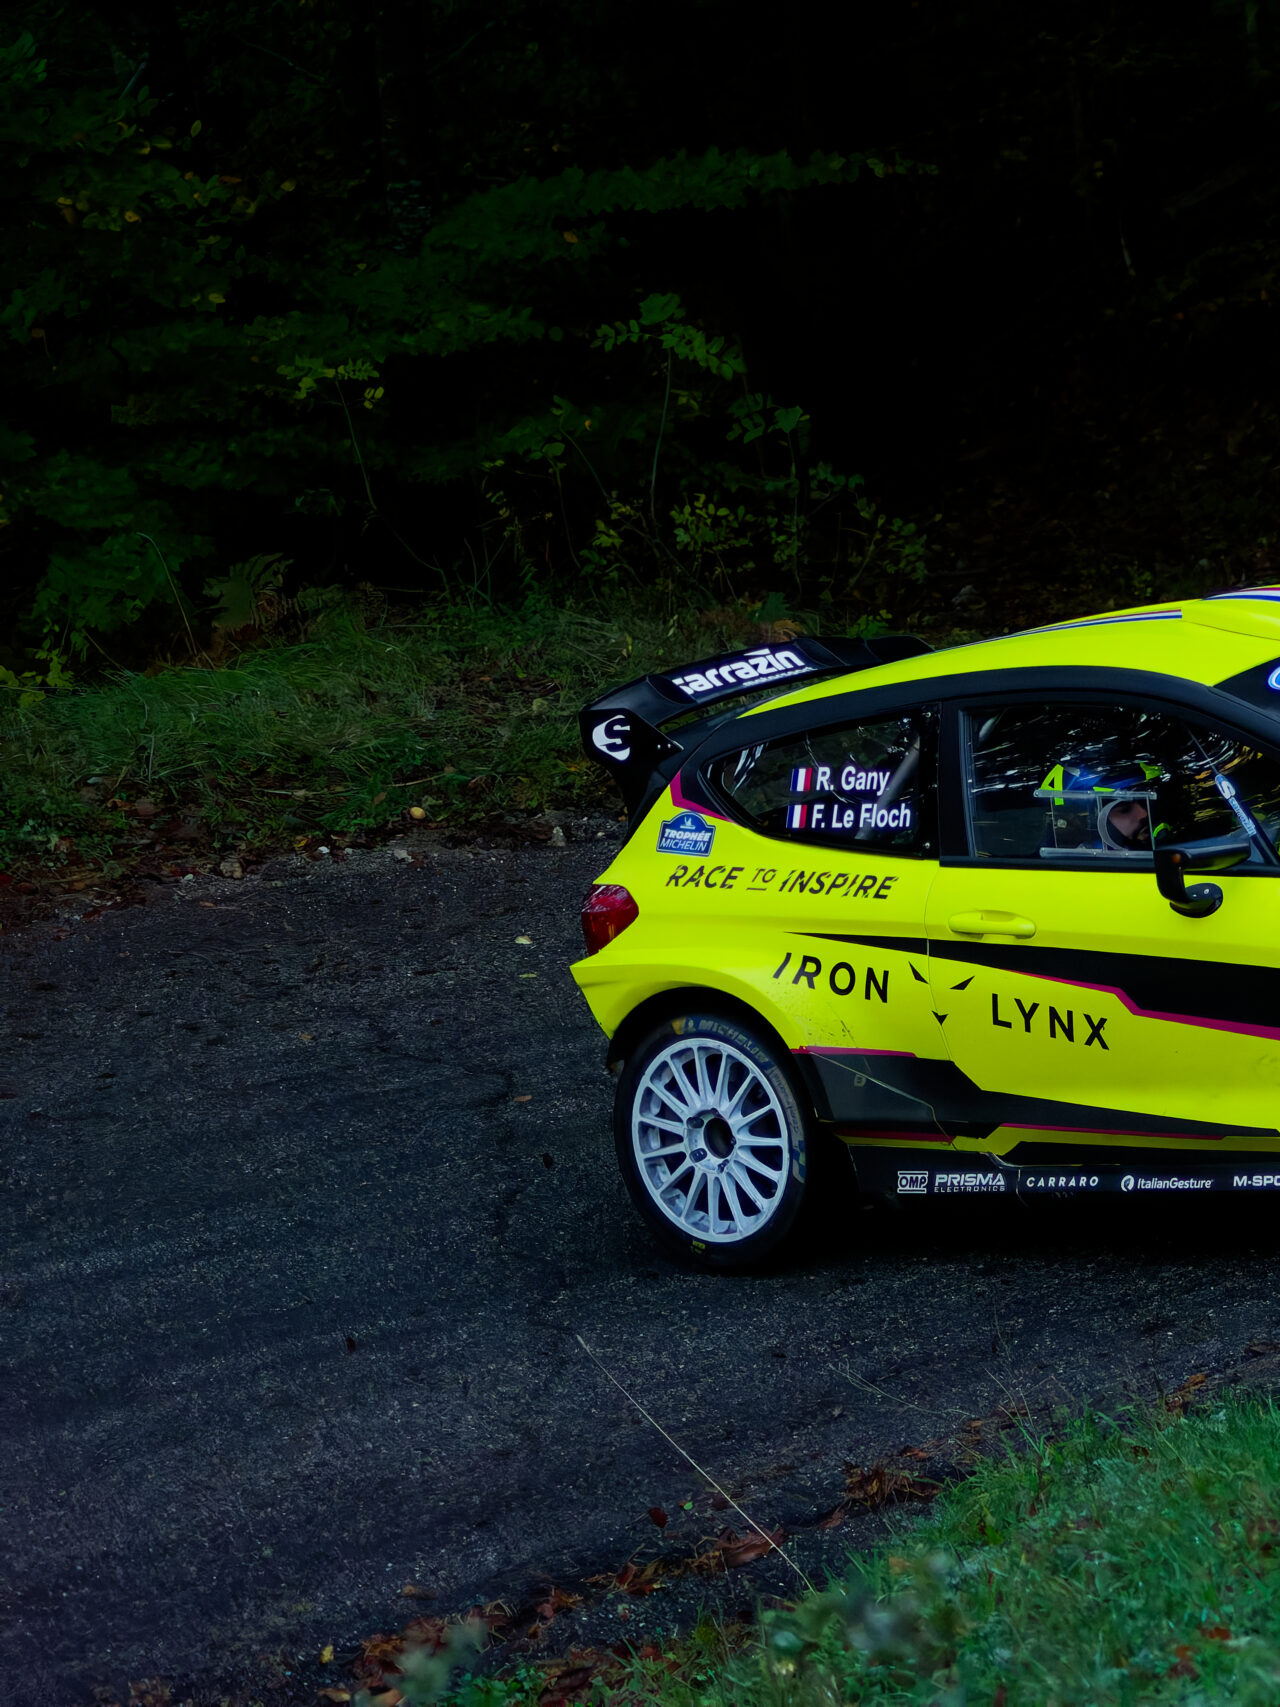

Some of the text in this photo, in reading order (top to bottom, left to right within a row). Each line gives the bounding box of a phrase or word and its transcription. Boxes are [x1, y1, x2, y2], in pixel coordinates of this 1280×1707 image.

[815, 766, 890, 796] R. Gany
[811, 803, 911, 829] F. Le Floch
[660, 838, 707, 851] MICHELIN
[664, 829, 711, 841] TROPHÉE
[665, 864, 900, 899] RACE TO INSPIRE
[772, 952, 889, 1004] IRON
[991, 993, 1110, 1050] LYNX
[898, 1176, 928, 1188] OMP
[935, 1173, 1006, 1186] PRISMA
[1026, 1176, 1099, 1188] CARRARO
